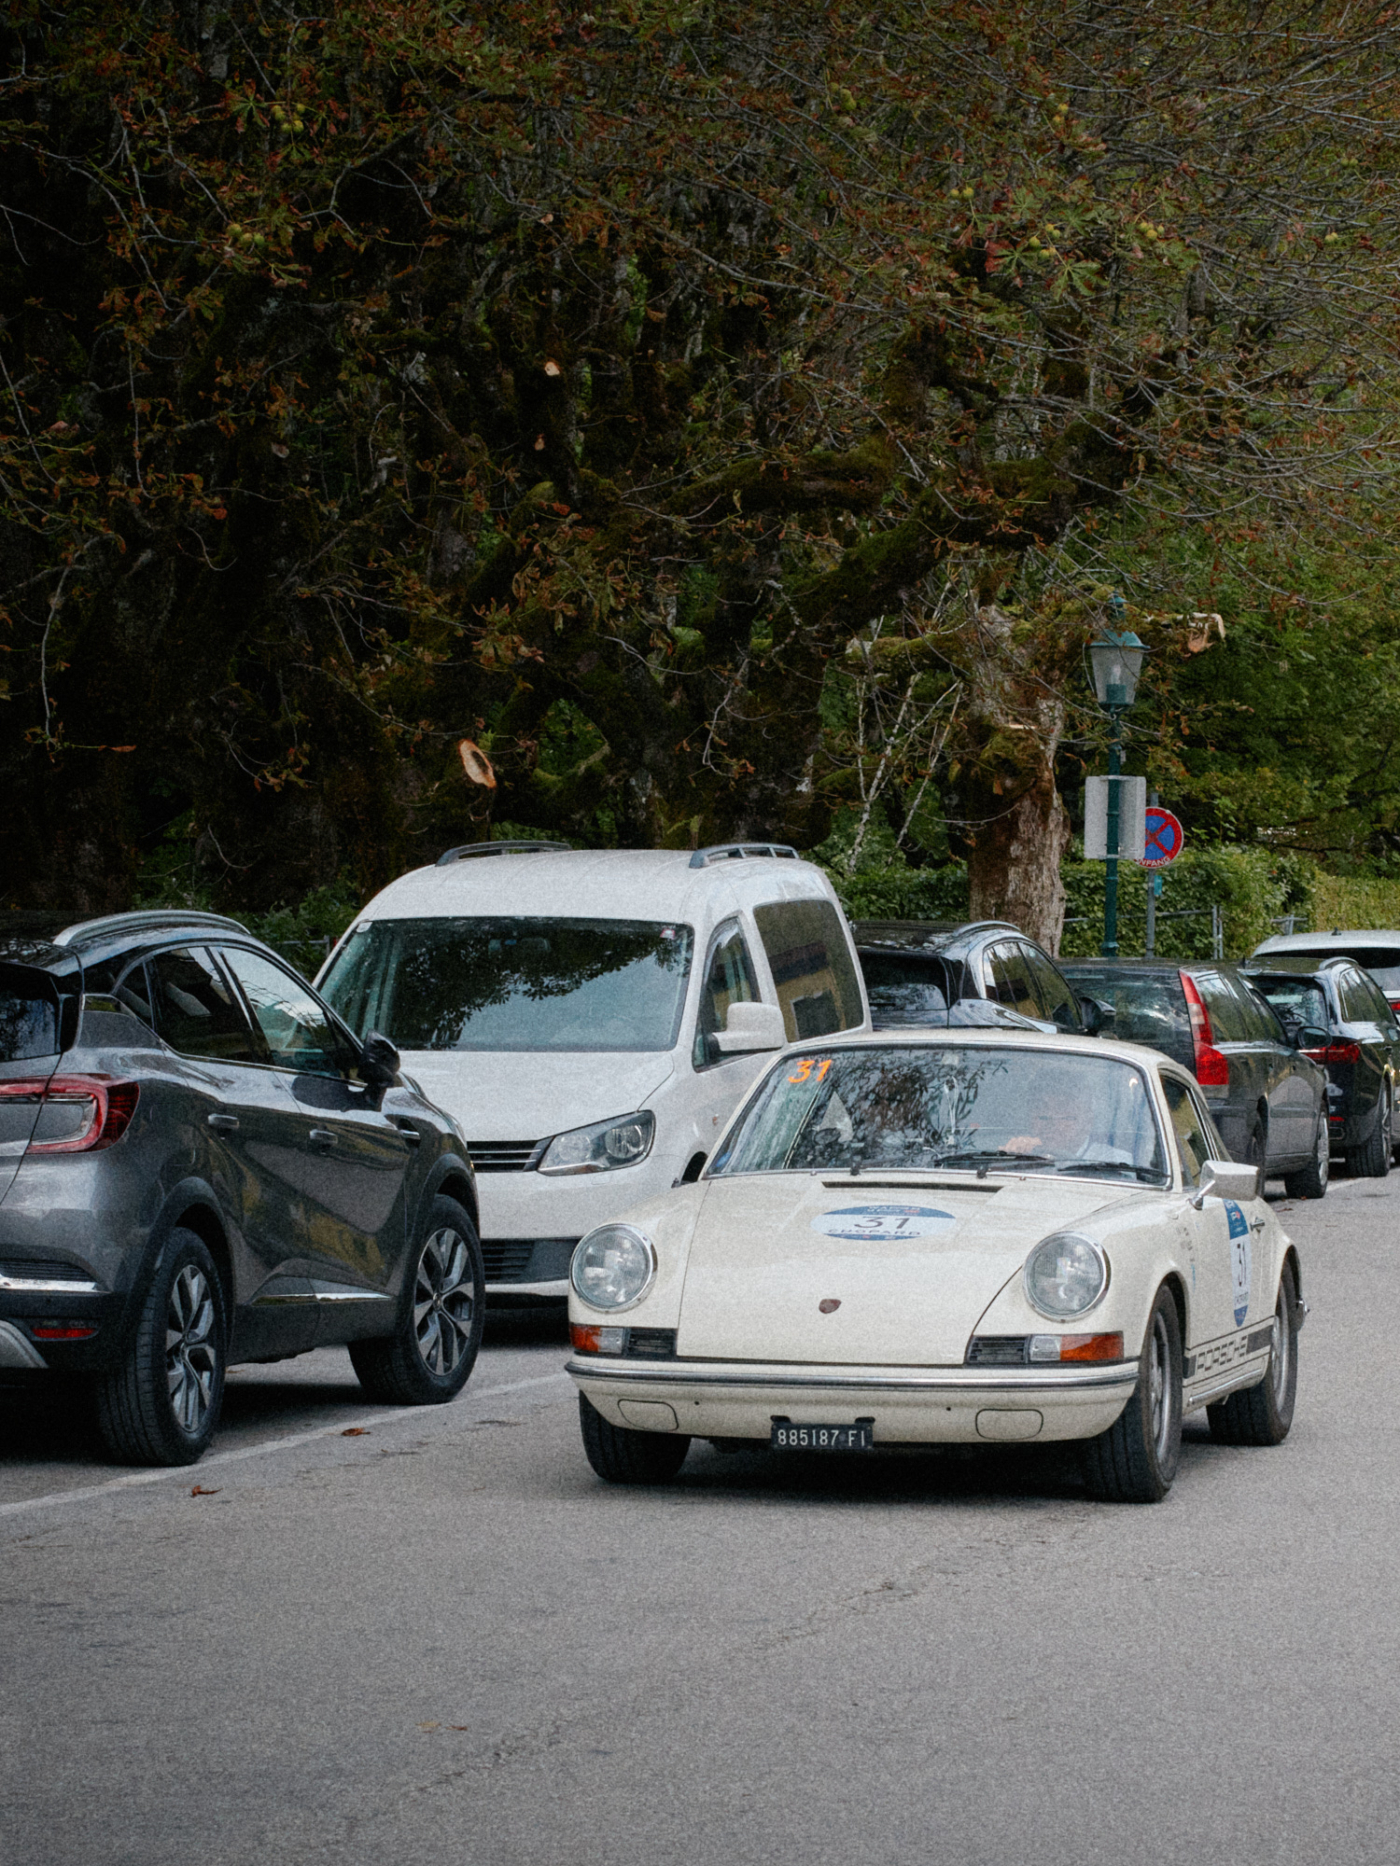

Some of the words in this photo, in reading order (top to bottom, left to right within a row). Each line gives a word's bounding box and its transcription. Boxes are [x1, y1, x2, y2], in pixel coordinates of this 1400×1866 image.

[1137, 856, 1171, 866] NFANG
[788, 1059, 832, 1083] 31
[854, 1216, 910, 1229] 31
[778, 1429, 839, 1446] 885187
[848, 1430, 865, 1446] FI
